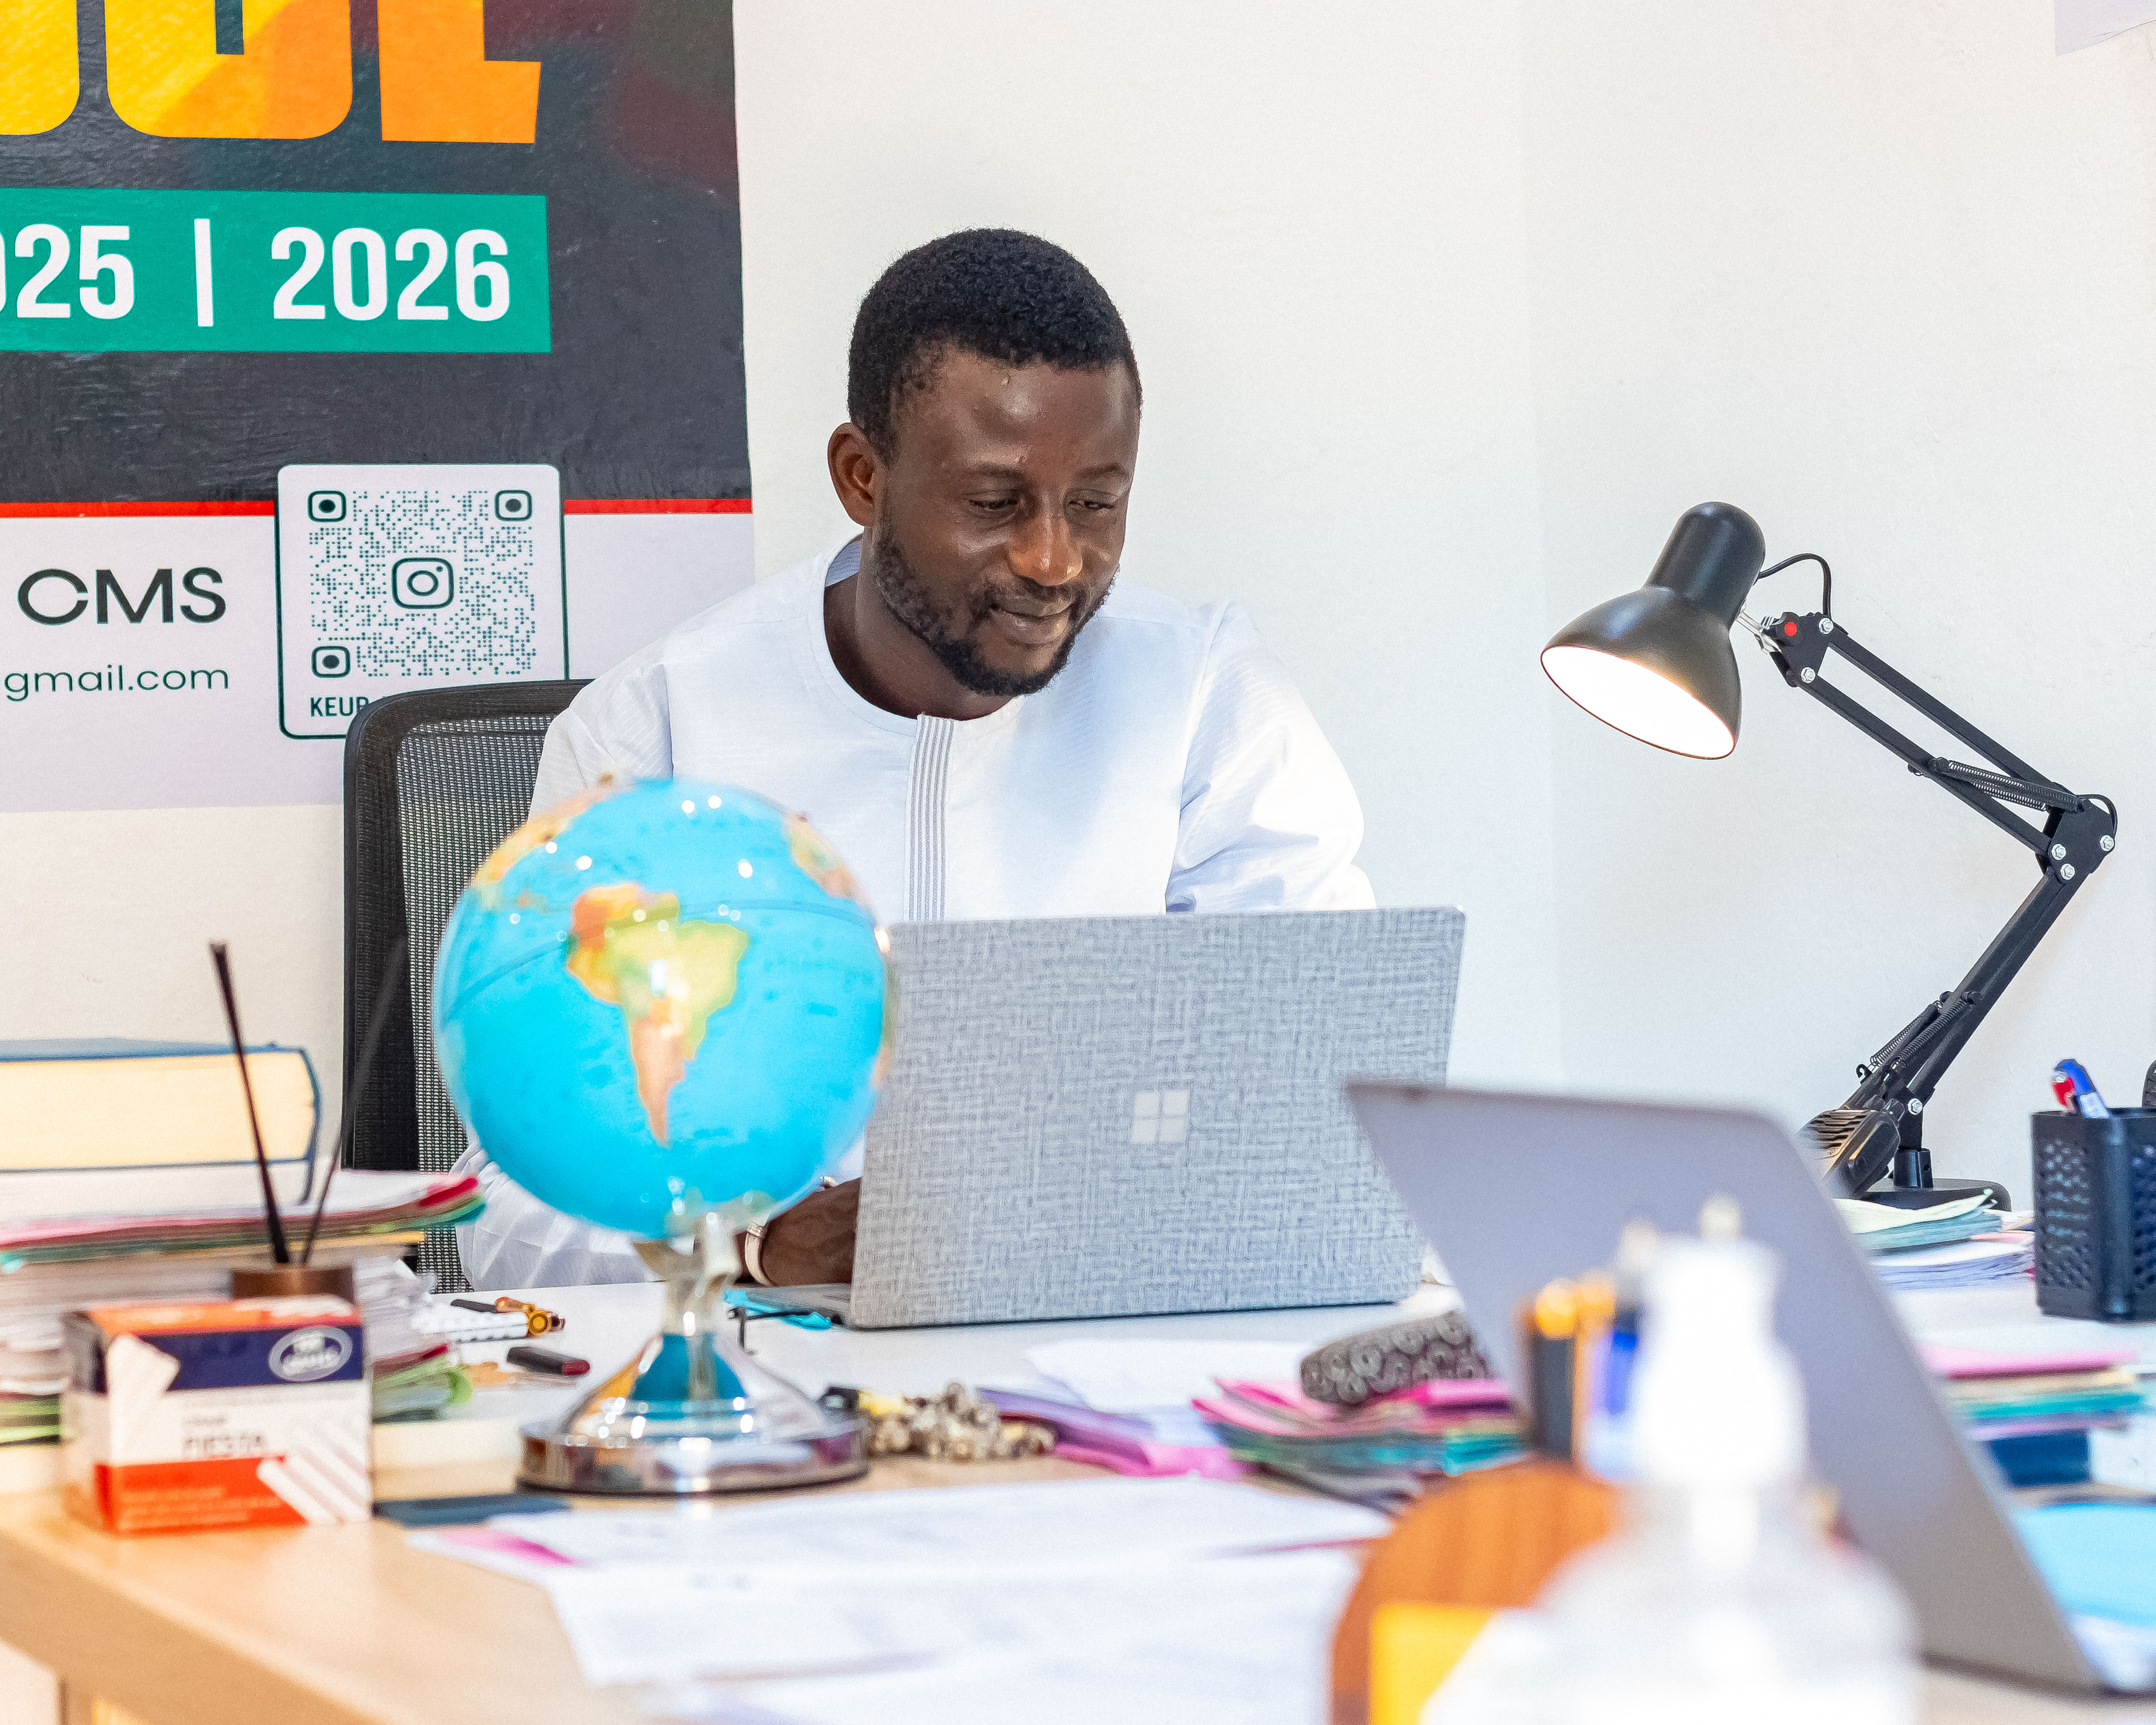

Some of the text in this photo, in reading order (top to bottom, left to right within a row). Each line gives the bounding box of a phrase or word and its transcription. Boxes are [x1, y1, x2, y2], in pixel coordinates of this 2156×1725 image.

[0, 223, 134, 319] 25
[271, 227, 510, 321] 2026
[17, 566, 226, 626] CMS
[4, 665, 229, 702] gmail.com
